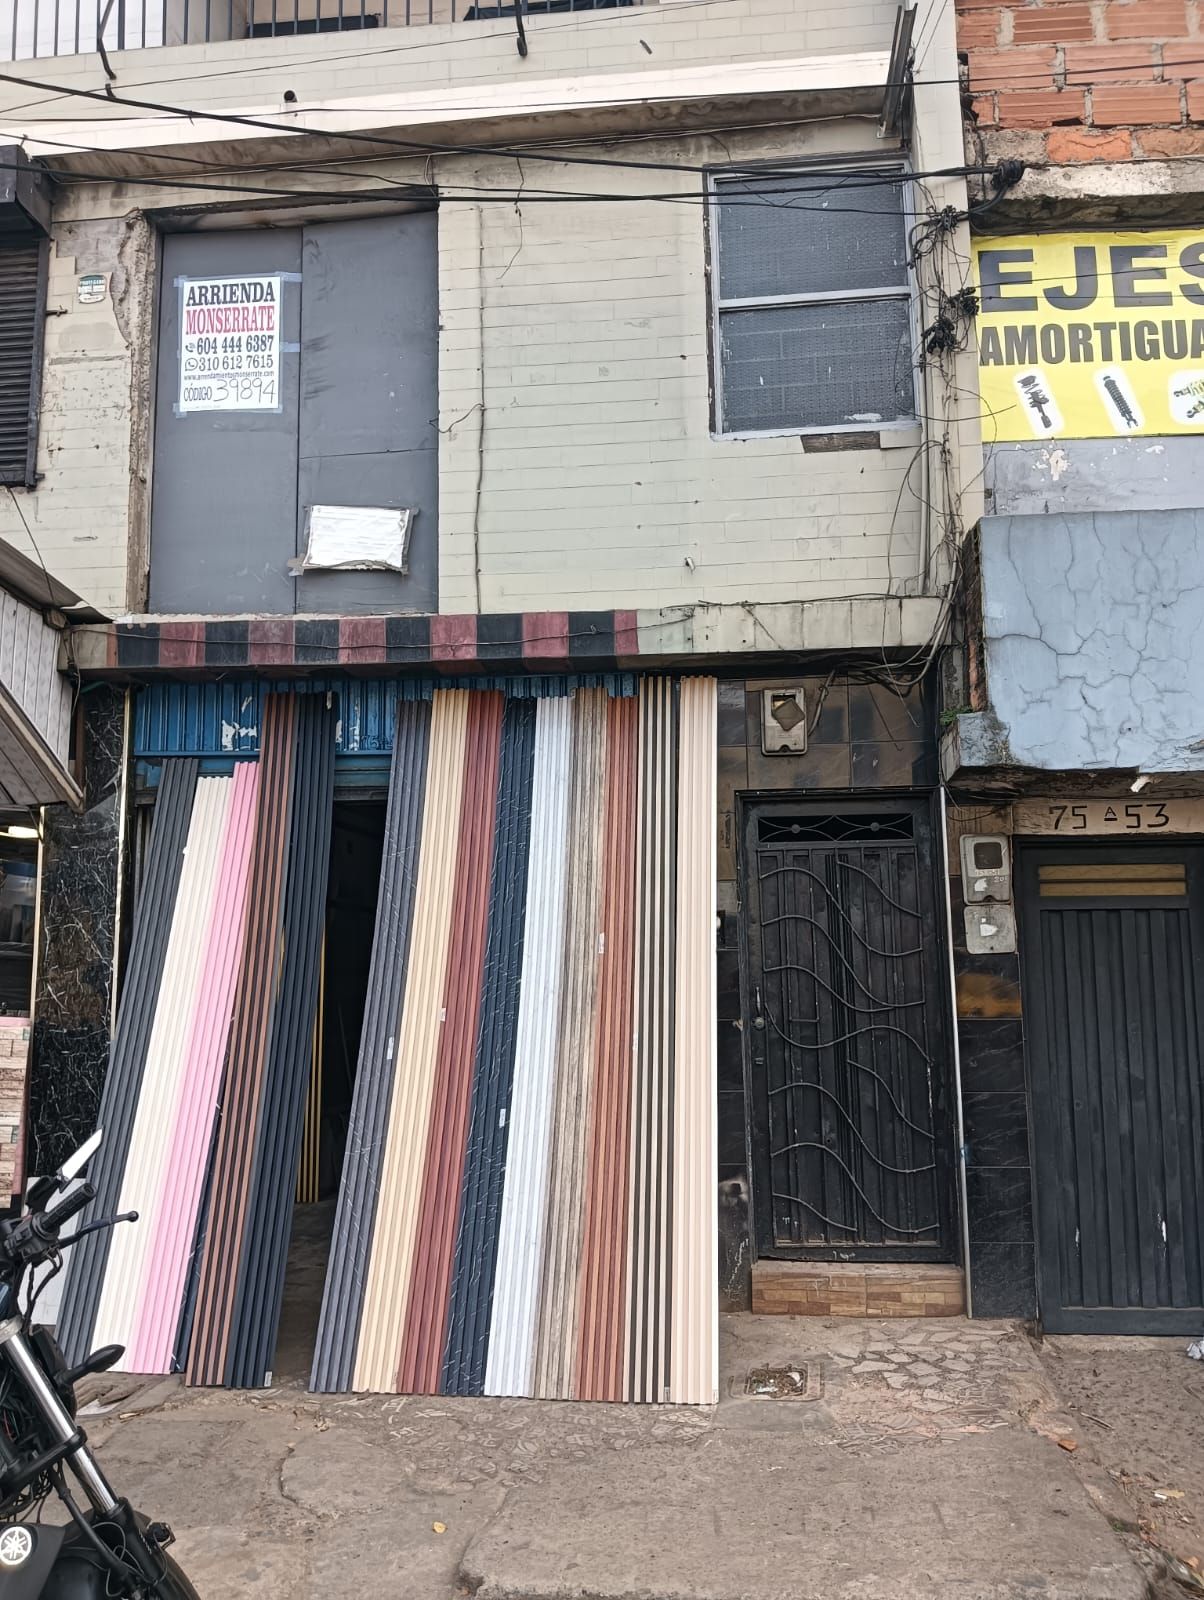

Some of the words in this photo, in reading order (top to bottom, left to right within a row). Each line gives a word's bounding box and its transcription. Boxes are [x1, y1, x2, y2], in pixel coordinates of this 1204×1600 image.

[186, 281, 275, 306] ARRIENDA
[186, 305, 275, 335] MONSERRATE
[197, 337, 218, 355] 604
[221, 336, 242, 353] 444
[246, 335, 274, 353] 6387
[199, 357, 219, 371] 310
[222, 355, 243, 370] 612
[246, 354, 274, 369] 7615
[184, 383, 212, 402] CÓDIGO
[213, 378, 276, 404] 39894
[1050, 805, 1088, 830] 75
[1125, 803, 1170, 829] 53
